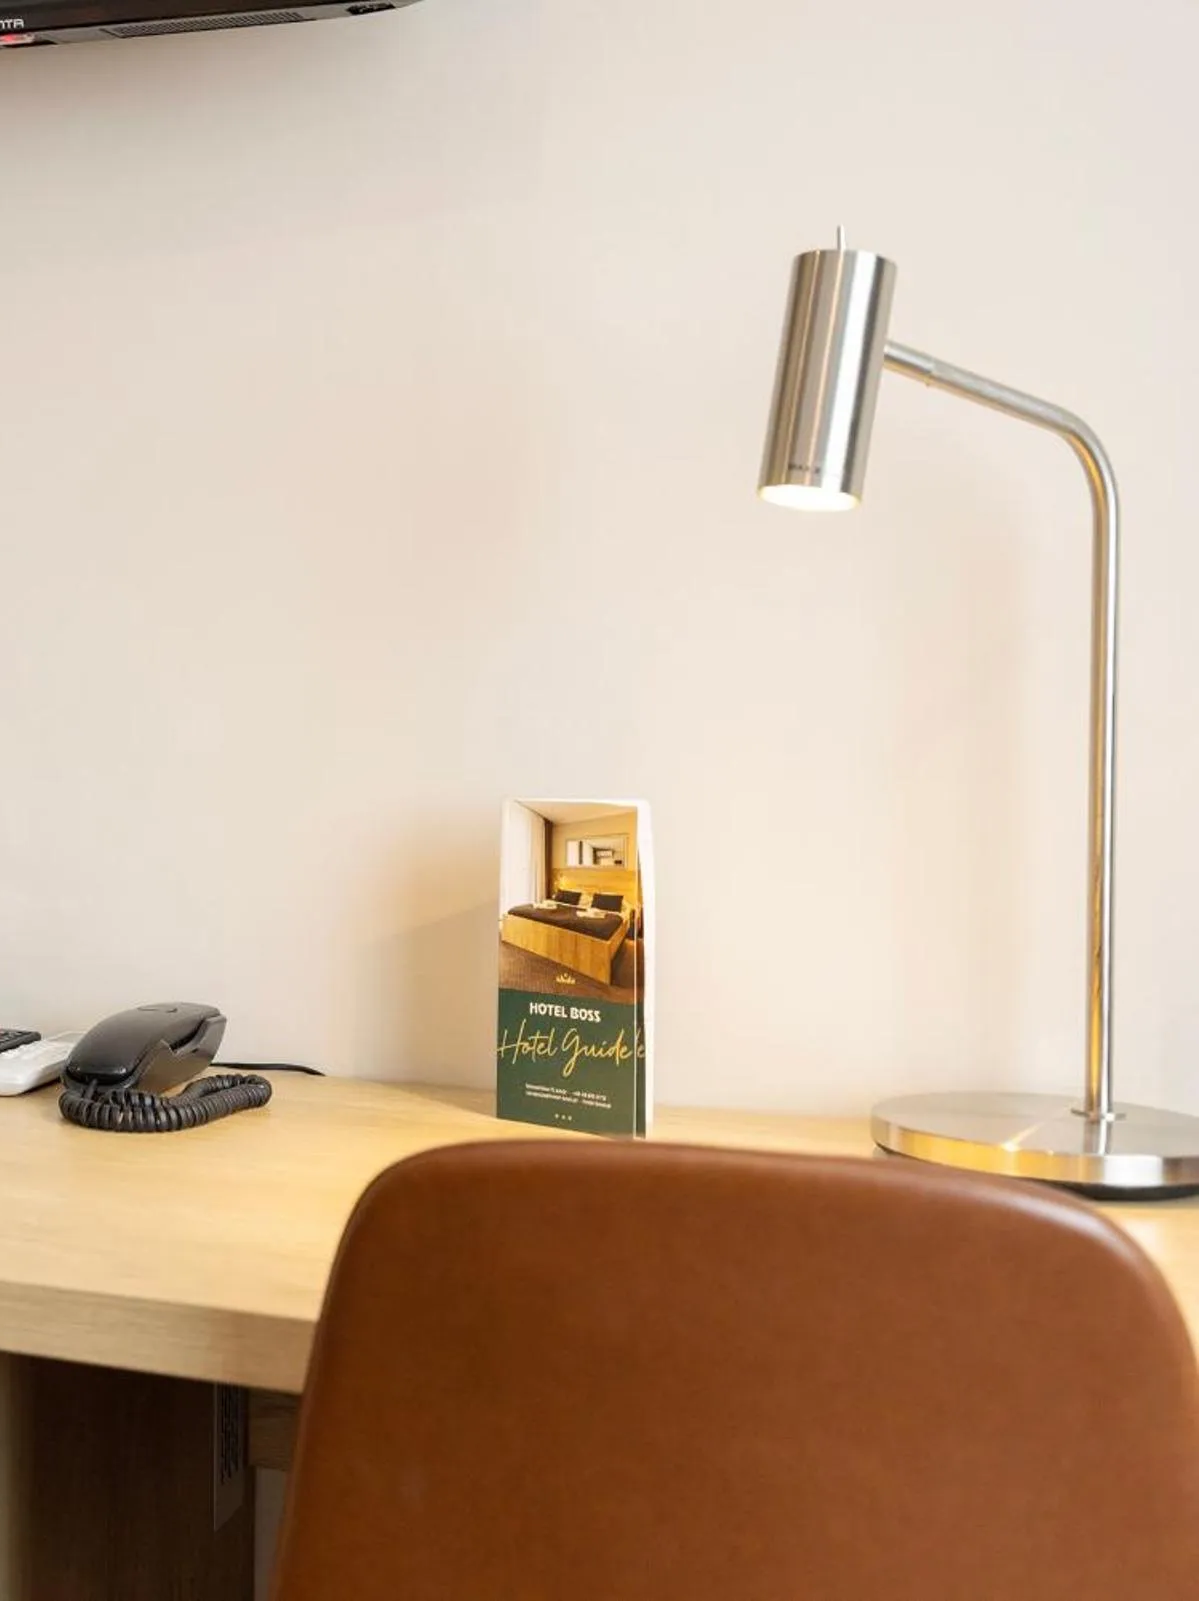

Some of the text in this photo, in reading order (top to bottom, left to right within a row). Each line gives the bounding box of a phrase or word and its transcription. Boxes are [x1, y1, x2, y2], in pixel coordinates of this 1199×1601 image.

[529, 1002, 601, 1023] HOTEL BOSS
[496, 1018, 558, 1065] Hotel
[561, 1028, 633, 1078] Guide
